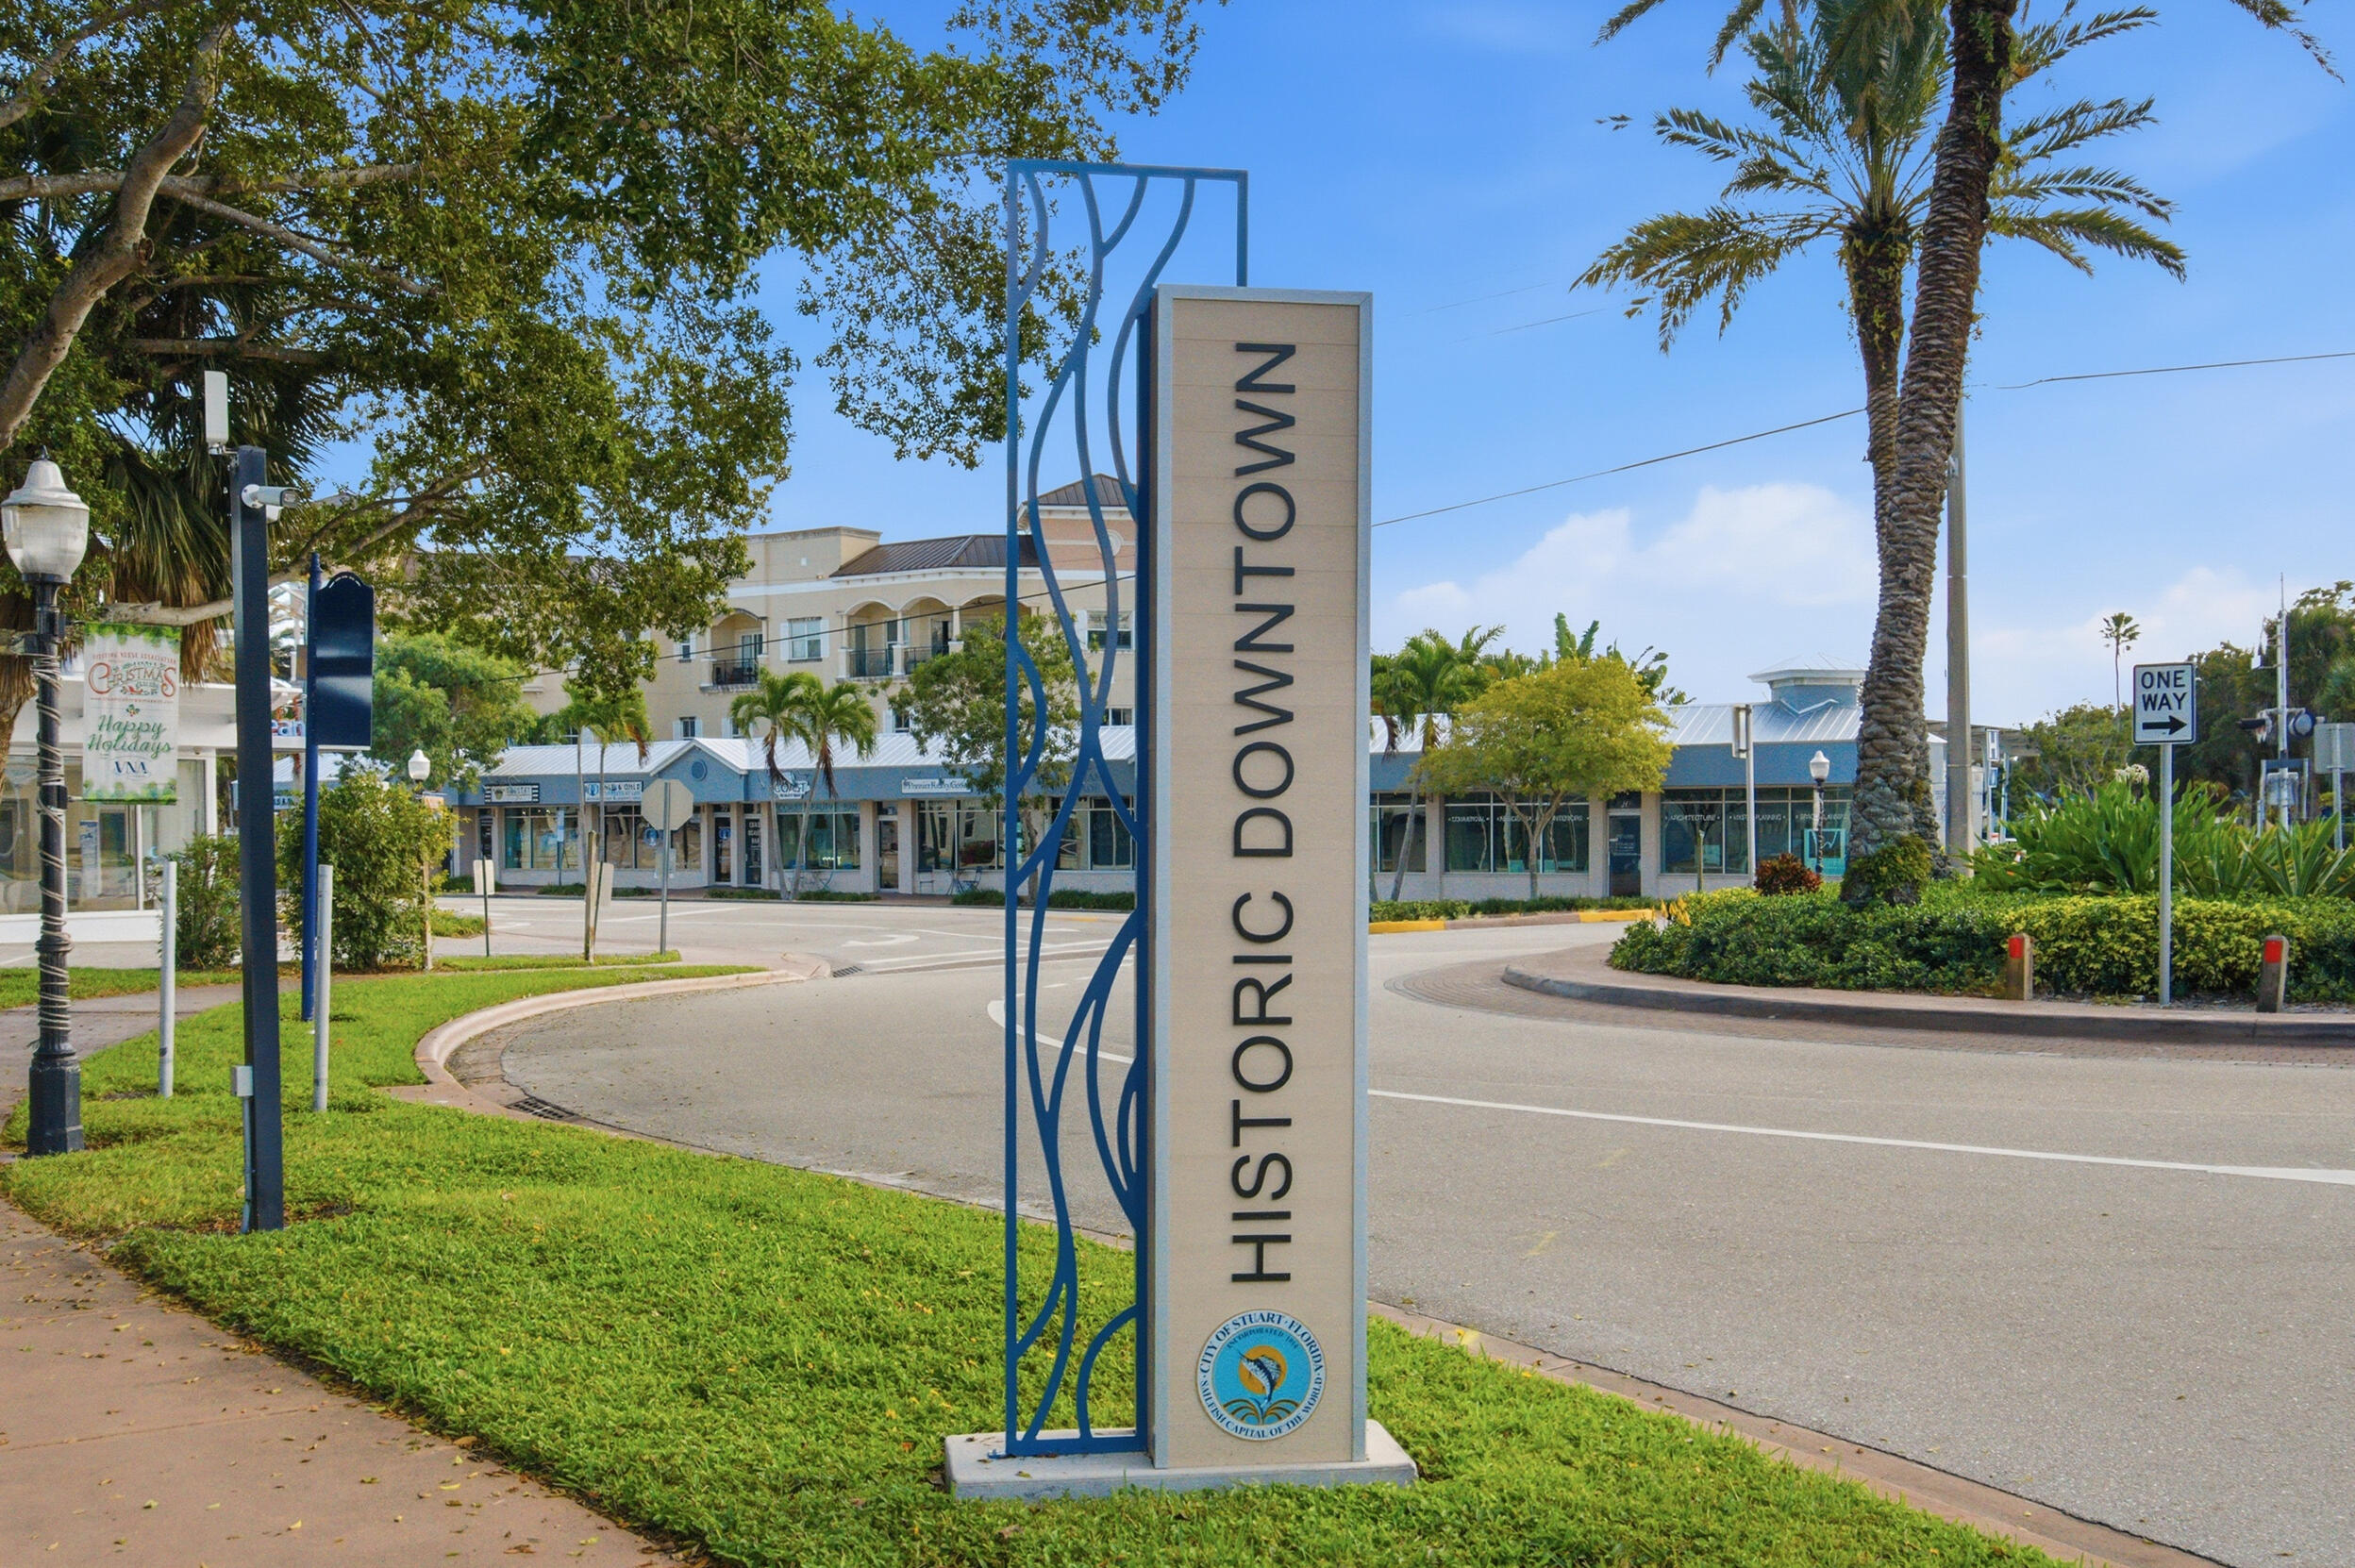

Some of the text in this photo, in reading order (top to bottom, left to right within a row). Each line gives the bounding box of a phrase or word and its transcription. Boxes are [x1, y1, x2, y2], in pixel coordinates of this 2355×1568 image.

[2141, 670, 2186, 690] ONE
[2142, 692, 2188, 711] WAY
[98, 715, 167, 741] Happy
[88, 733, 174, 759] Holidays
[1230, 342, 1295, 1283] HISTORIC DOWNTOWN
[1199, 1312, 1324, 1374] CITY OF STUART FLORIDA
[1200, 1377, 1323, 1439] SAILFISH CAPITAL OF THE WORLD
